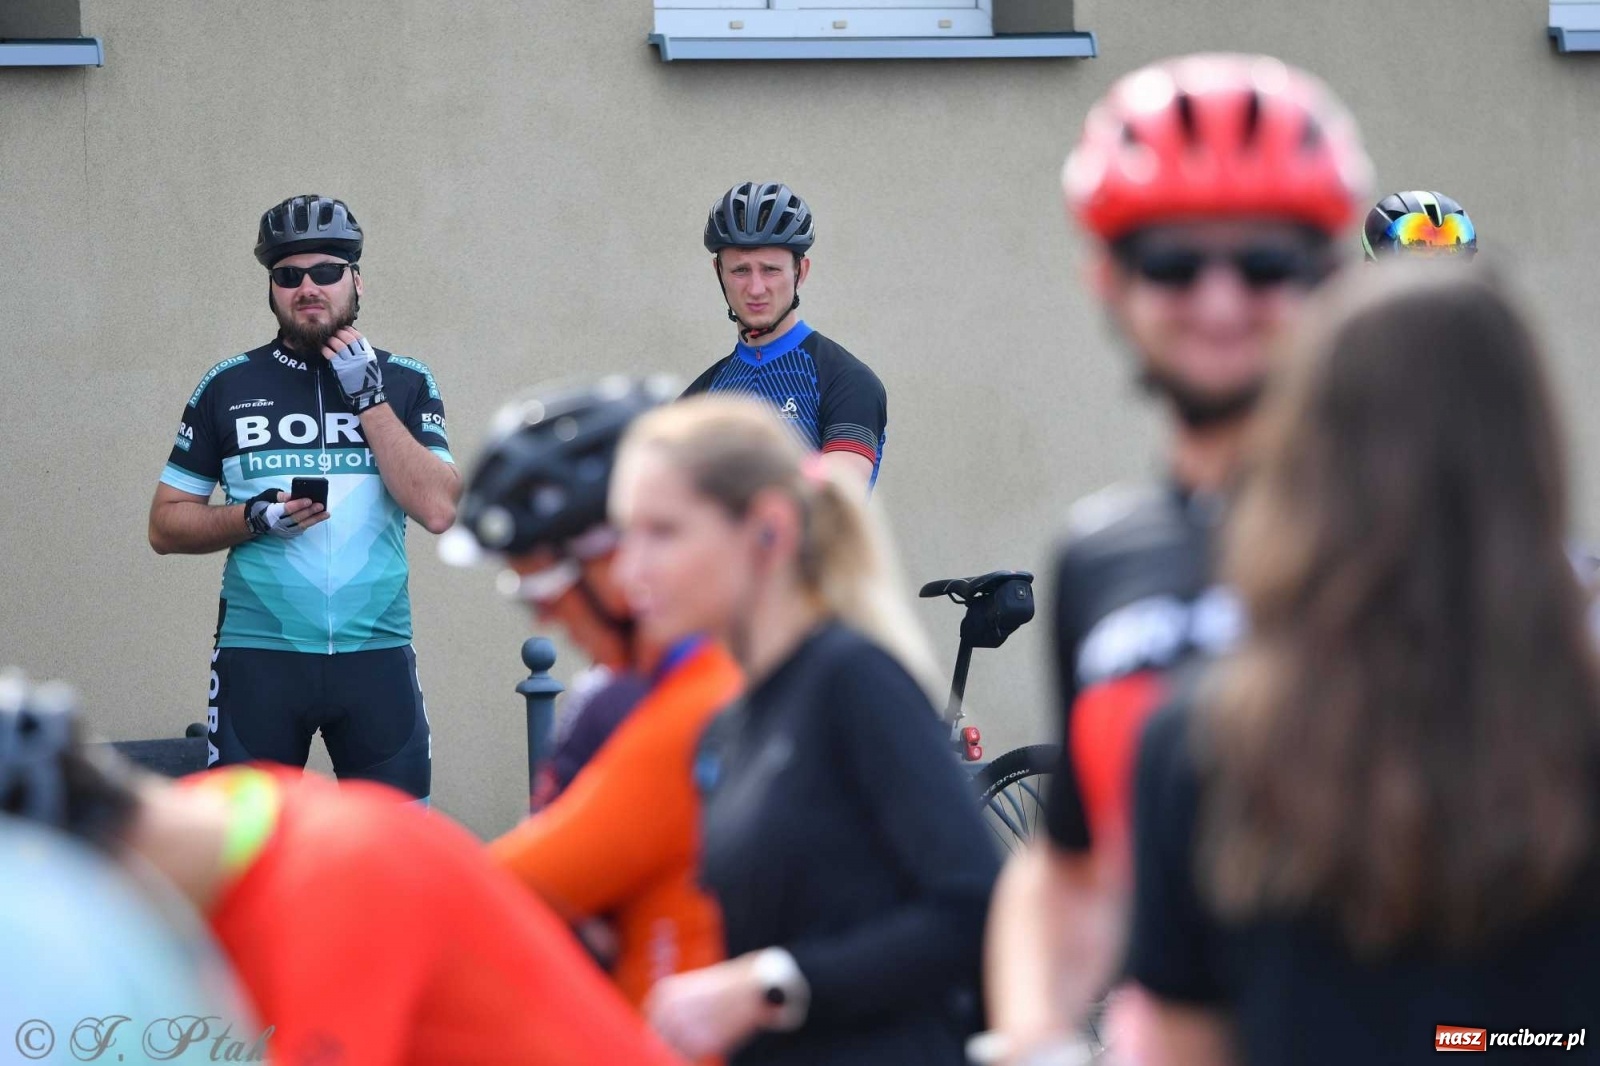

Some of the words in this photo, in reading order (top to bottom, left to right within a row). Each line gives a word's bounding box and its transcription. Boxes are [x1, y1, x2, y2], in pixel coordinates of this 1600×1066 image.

[272, 349, 308, 371] BORA
[189, 354, 246, 405] hansgrohe
[229, 402, 252, 411] AUTO
[252, 400, 274, 408] EDER
[235, 412, 365, 449] BOR
[249, 448, 378, 471] hansgroh
